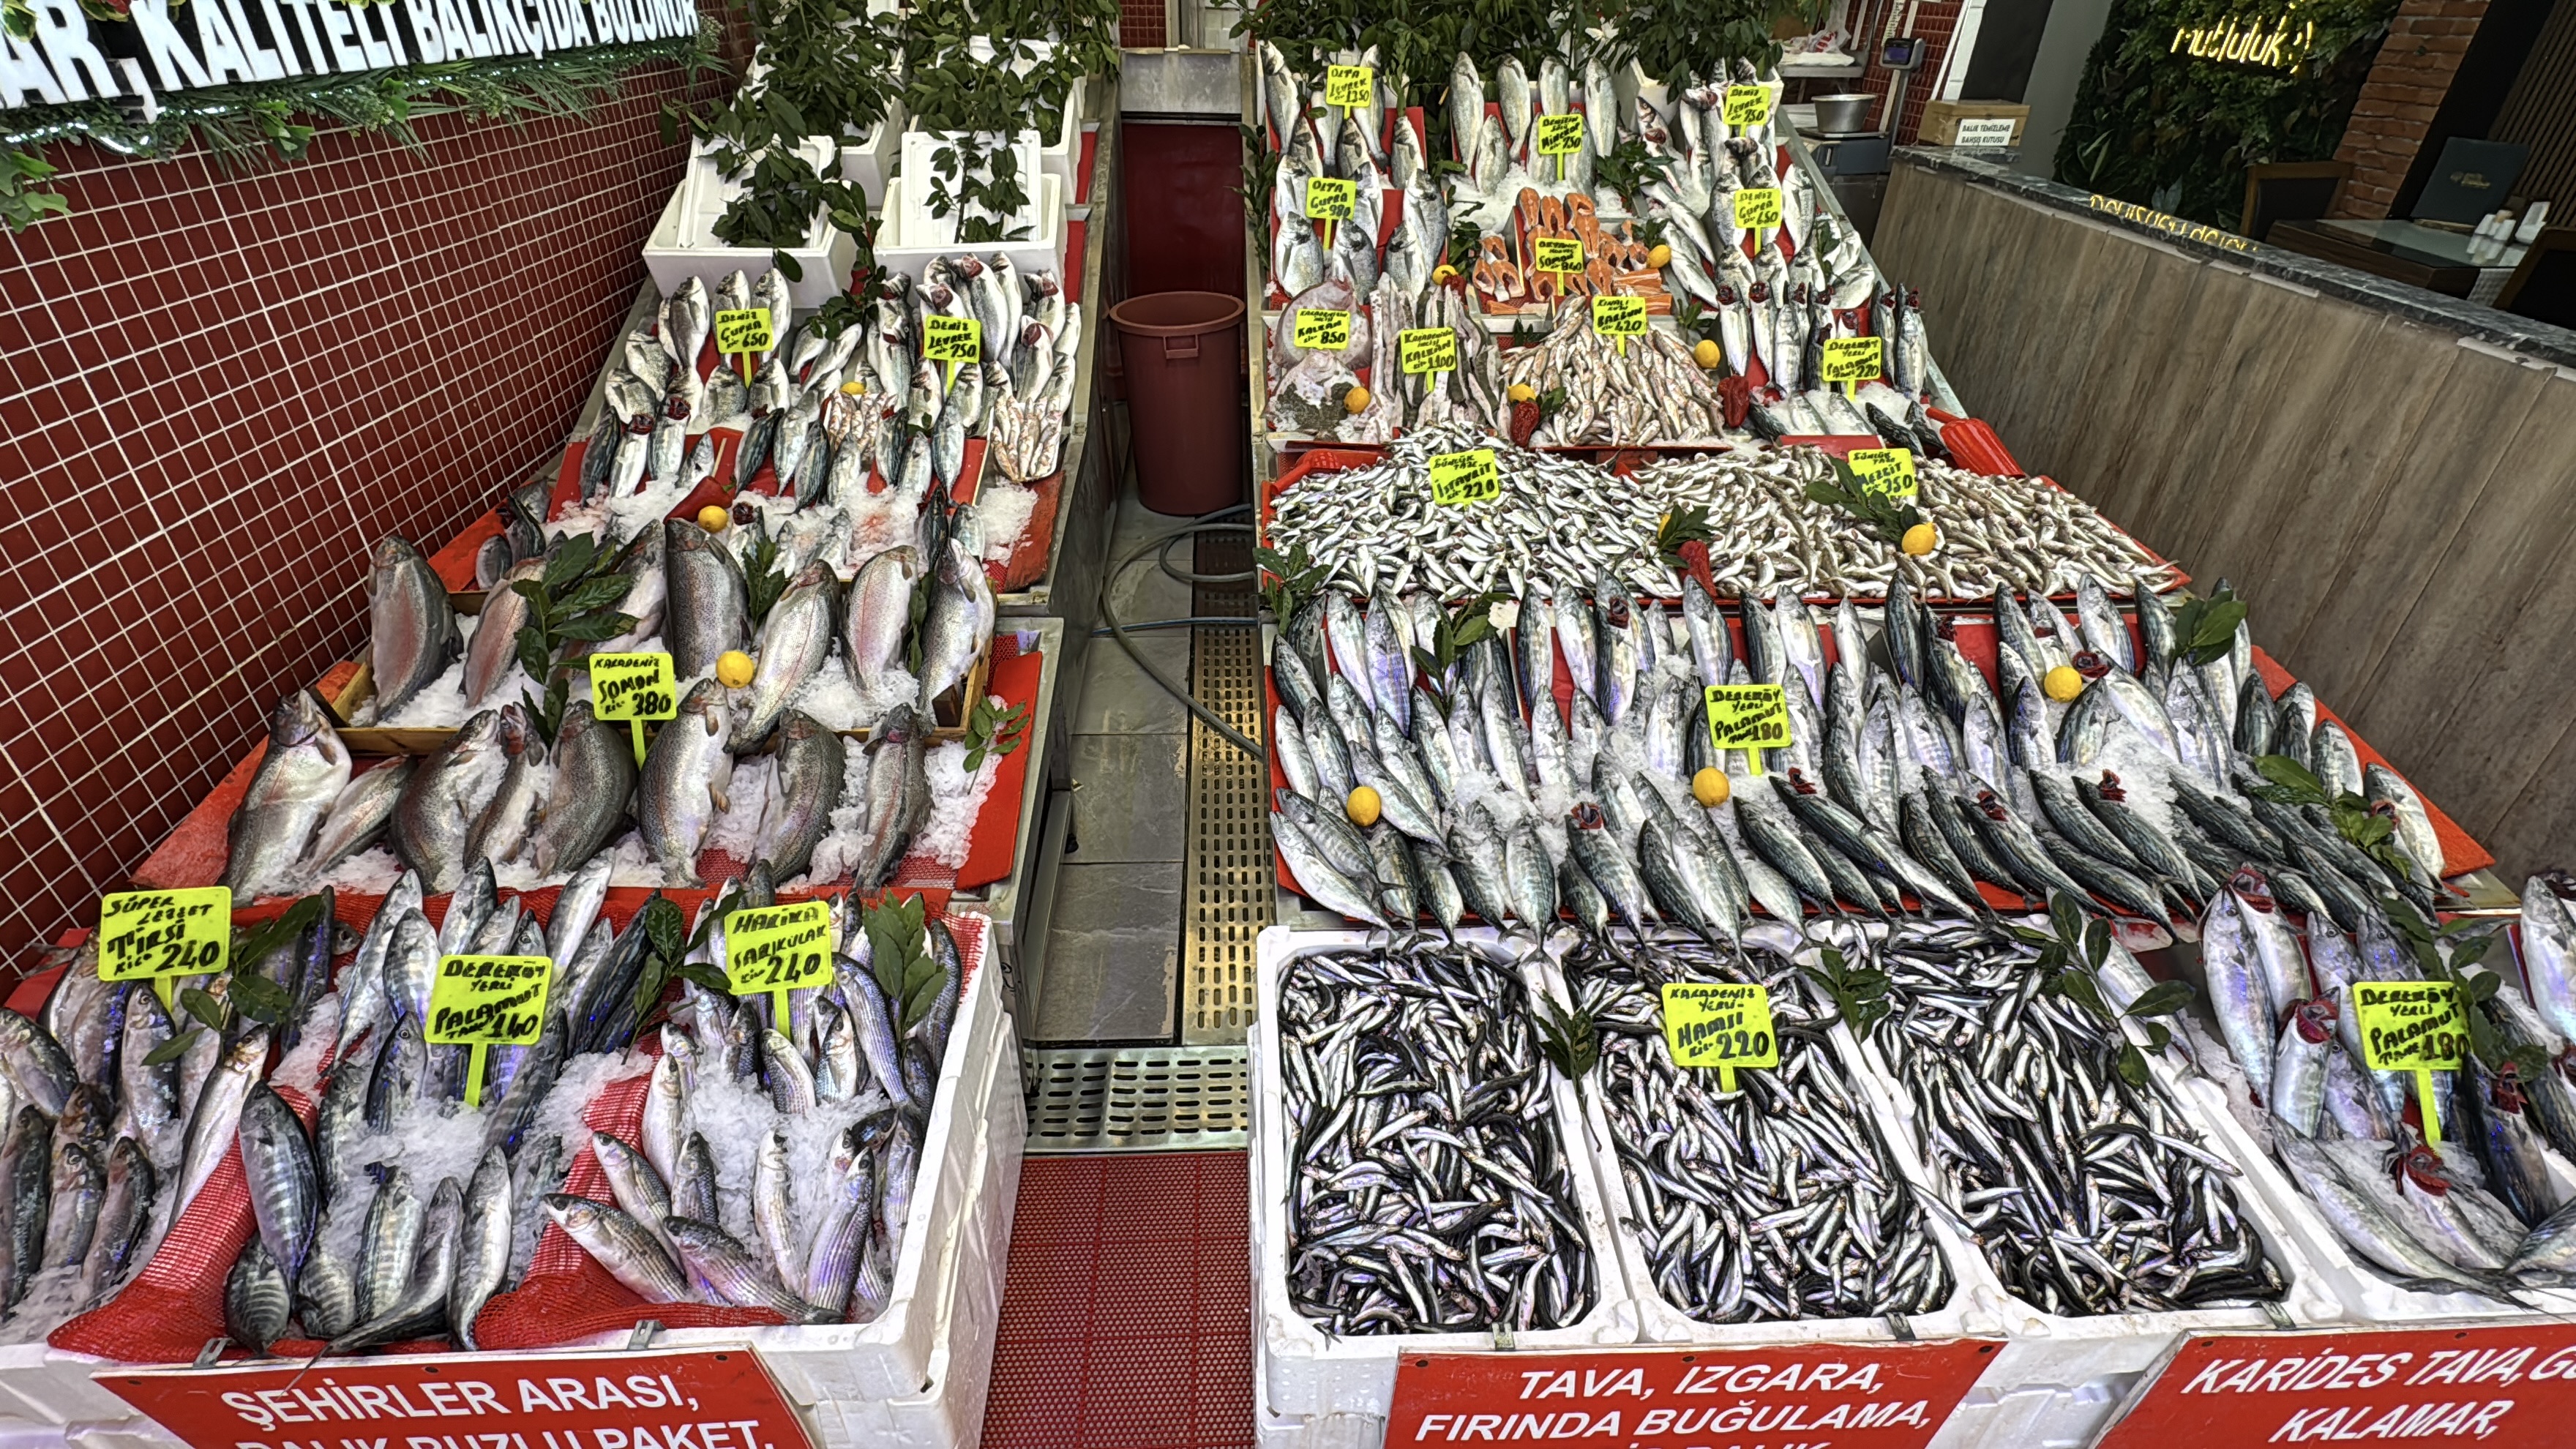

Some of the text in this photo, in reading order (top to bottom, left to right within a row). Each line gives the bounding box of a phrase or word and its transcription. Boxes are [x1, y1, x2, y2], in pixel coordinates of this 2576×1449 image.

[1344, 89, 1369, 103] 1350
[1743, 109, 1764, 122] 750
[1562, 135, 1581, 149] 750
[1329, 204, 1351, 217] 980
[1756, 211, 1778, 225] 650
[1561, 261, 1581, 271] 840
[1298, 320, 1341, 338] KALKAN
[1614, 320, 1641, 332] 420
[742, 332, 769, 348] 650
[927, 332, 973, 349] LEVREK
[1320, 331, 1346, 345] 850
[949, 343, 976, 358] 750
[1405, 340, 1451, 364] KALKAN
[1427, 354, 1454, 369] 1100
[1856, 364, 1879, 378] 220
[1462, 479, 1495, 498] 220
[1882, 474, 1913, 494] 350
[598, 668, 659, 704] SOMON
[632, 691, 671, 716] 380
[1715, 703, 1782, 741] PALAMUT
[1750, 722, 1783, 741] 180
[104, 895, 175, 918] SÜPER
[107, 918, 185, 959] TİRSİ
[154, 940, 220, 972] 240
[765, 953, 821, 984] 240
[434, 983, 542, 1035] PALAMUT
[483, 1013, 539, 1039] 140
[2370, 1003, 2458, 1055] PALAMUT
[1716, 1030, 1769, 1059] 220
[2419, 1032, 2471, 1061] 180
[1520, 1363, 1885, 1401] TAVA, IZGARA,
[2180, 1347, 2414, 1394] KARİDES
[221, 1374, 699, 1431] ŞEHİRLER ARASI,
[1415, 1399, 1931, 1442] FIRINDA BUĞULAMA,
[2268, 1400, 2515, 1442] KALAMAR,
